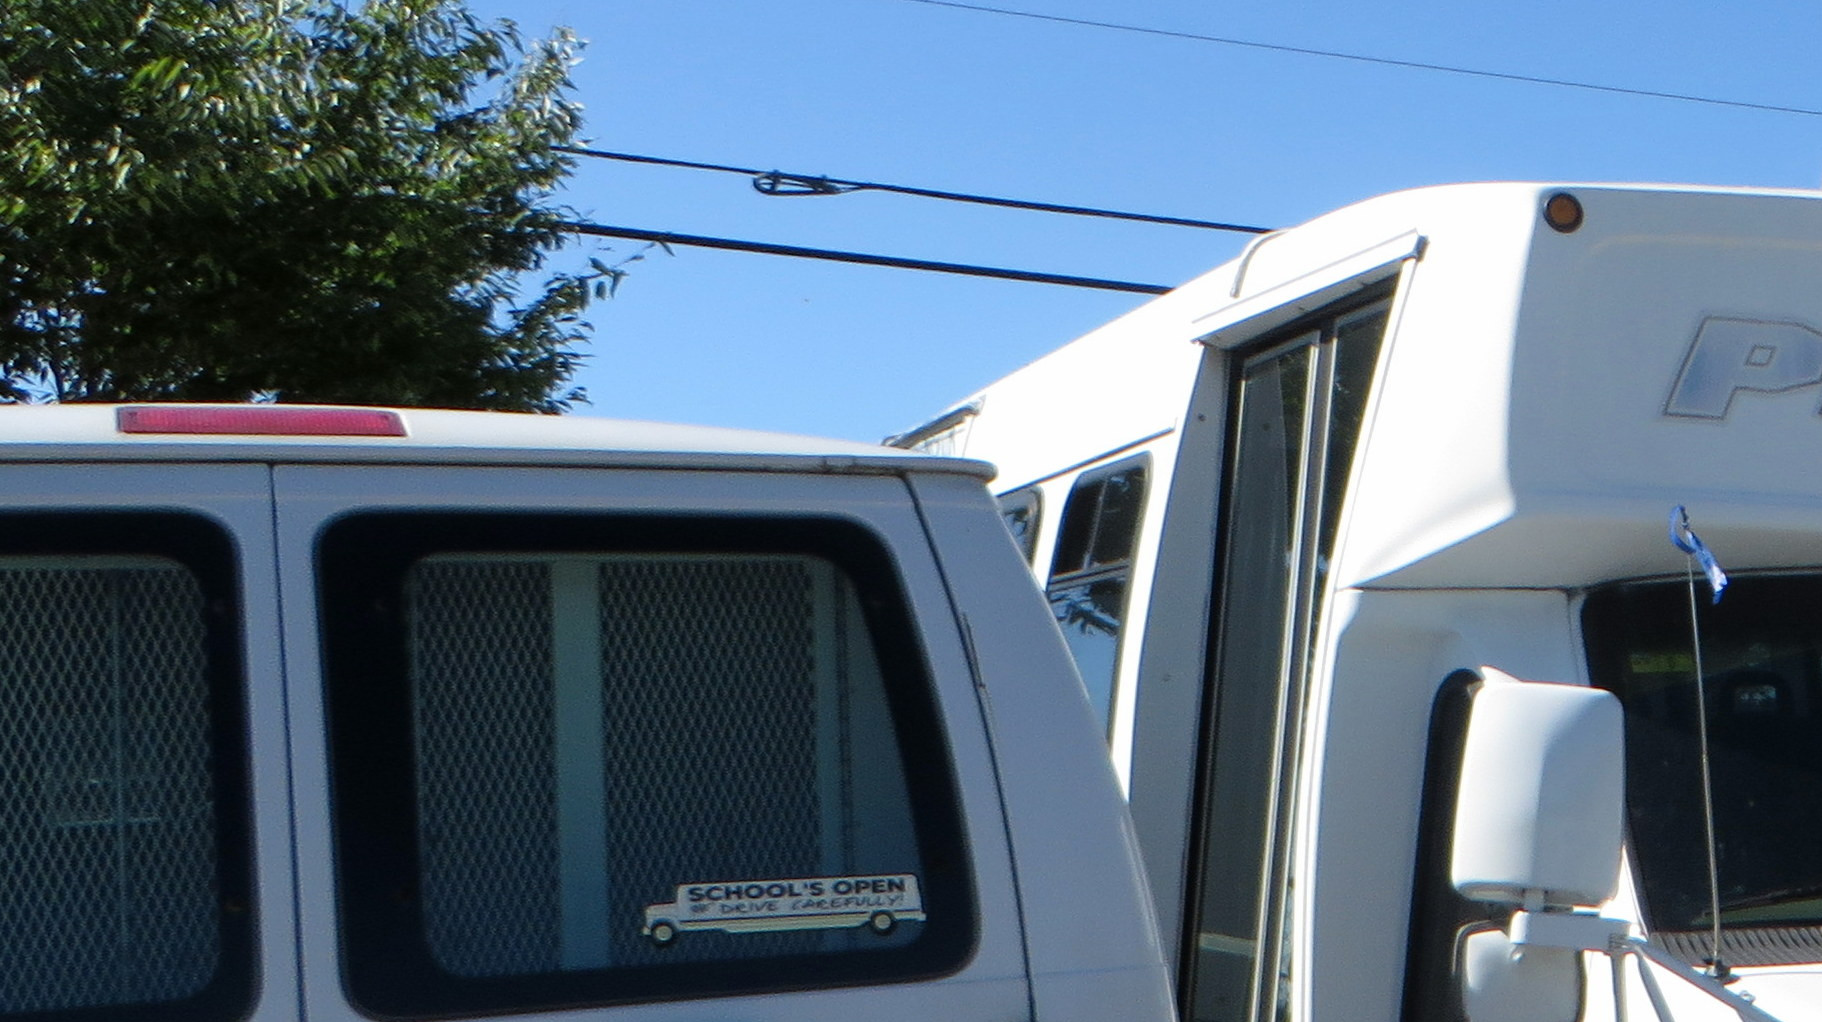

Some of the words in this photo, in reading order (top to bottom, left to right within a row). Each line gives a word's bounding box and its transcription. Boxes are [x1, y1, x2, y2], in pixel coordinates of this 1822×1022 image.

[688, 881, 825, 901] SCHOOL'S
[832, 878, 906, 895] OPEN
[721, 901, 778, 914] DRIVE
